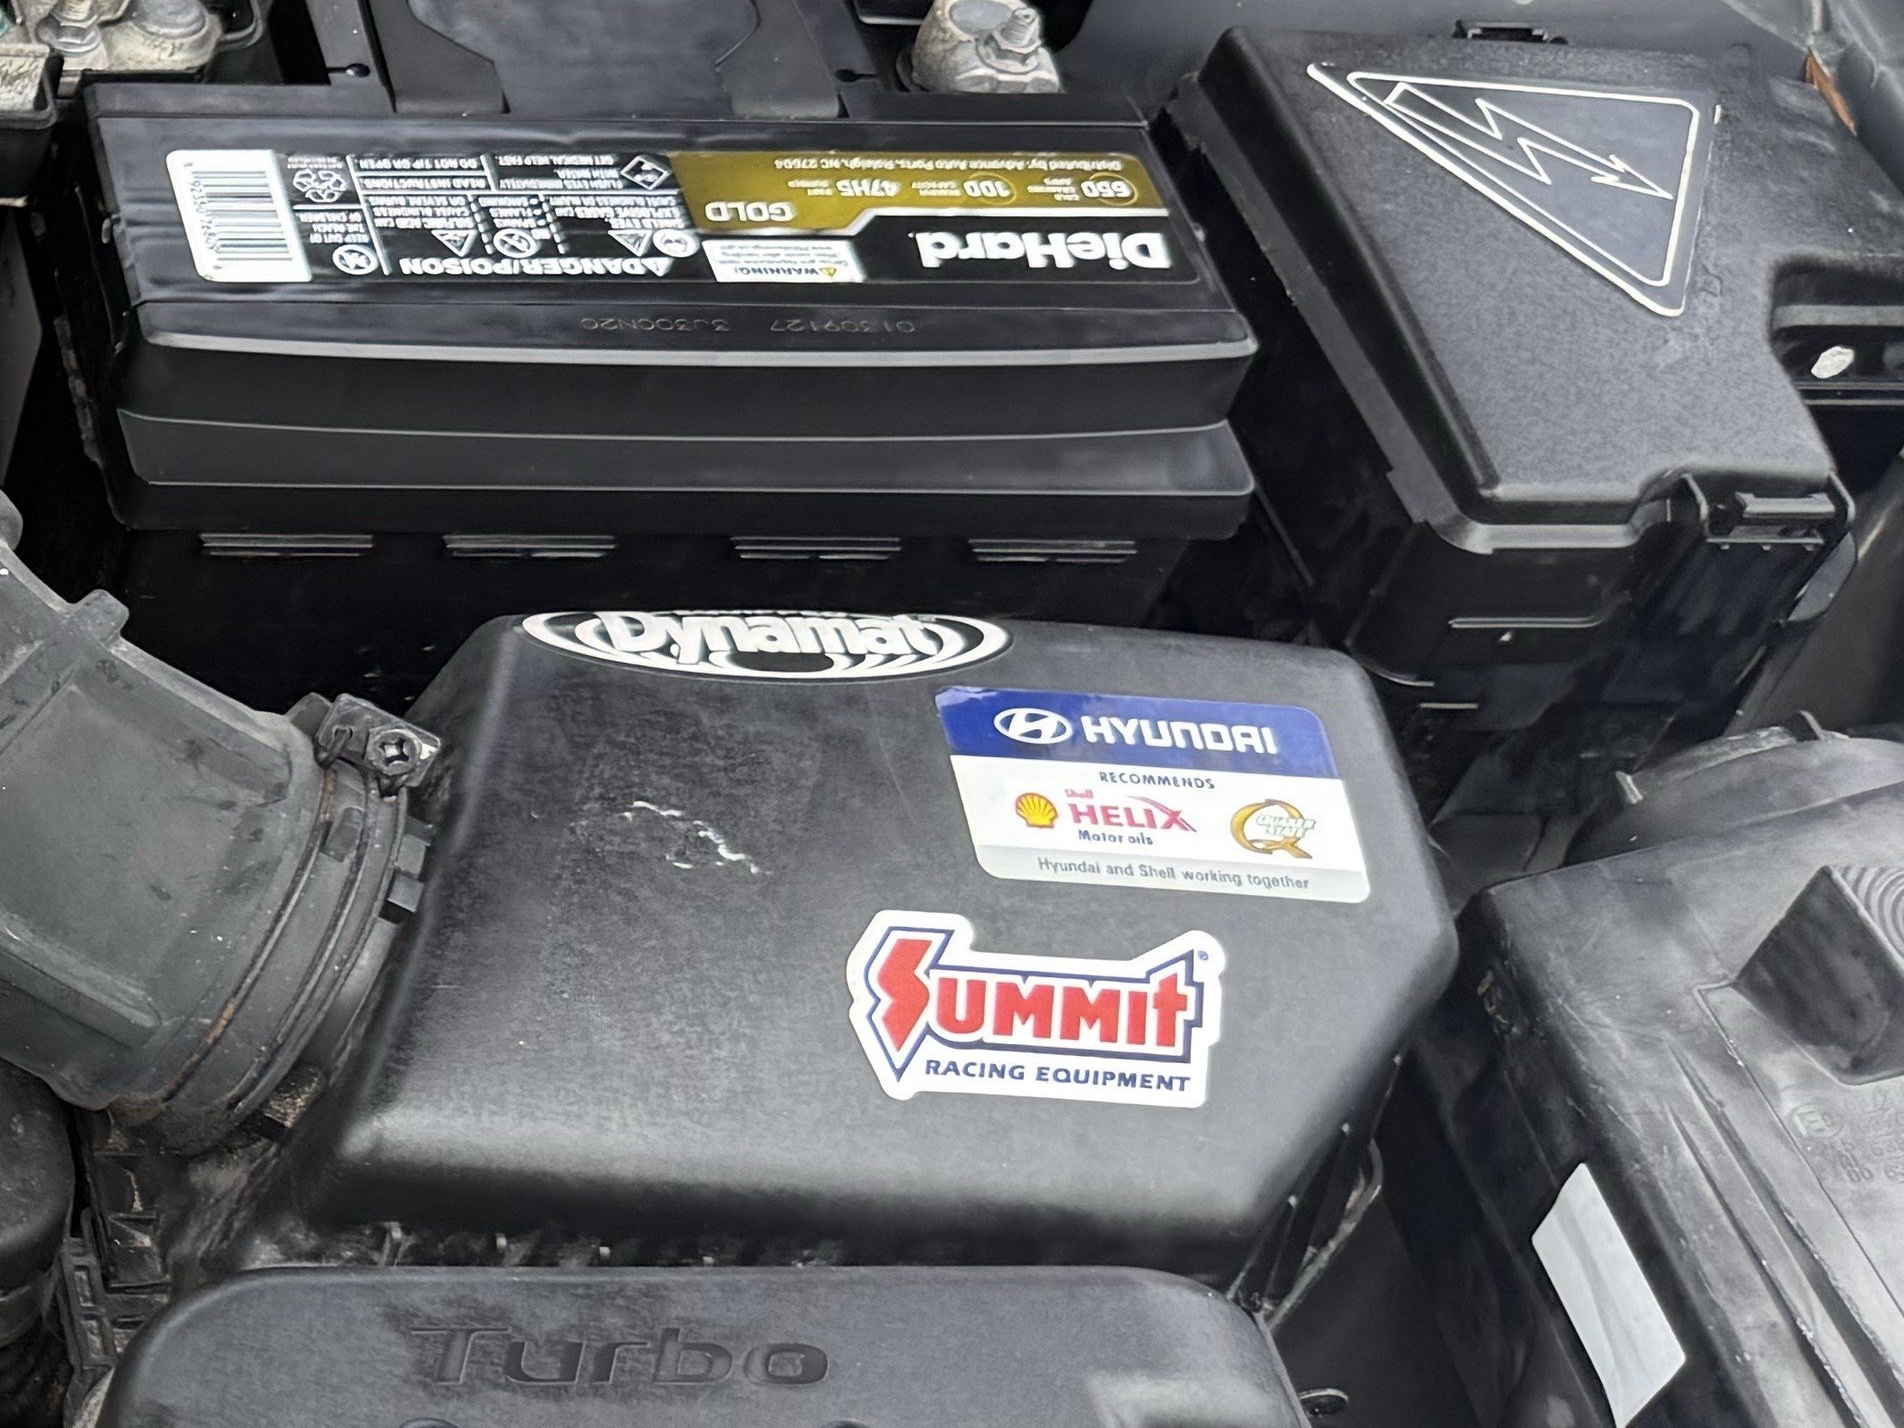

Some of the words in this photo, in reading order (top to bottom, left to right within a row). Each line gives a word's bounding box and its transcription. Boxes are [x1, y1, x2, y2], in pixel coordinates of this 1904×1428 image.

[820, 159, 840, 168] NC
[935, 160, 967, 170] Auto
[969, 160, 1025, 170] Advance
[836, 179, 900, 196] 47H5
[963, 180, 1010, 198] 100
[1081, 180, 1132, 198] 650
[704, 201, 793, 221] GOLD
[399, 258, 646, 274] DANGER/POISON
[602, 609, 940, 664] Dynamat
[1080, 715, 1277, 754] HYUNDAI
[1100, 772, 1215, 790] RECOMMENDS
[1068, 798, 1195, 832] HELIX
[1078, 830, 1123, 843] Motor
[1128, 832, 1153, 846] oils
[1038, 857, 1101, 878] Hyundai
[1106, 864, 1135, 878] and
[1139, 862, 1176, 880] Shell
[1182, 869, 1243, 888] working
[1247, 871, 1309, 891] together
[926, 1059, 1025, 1082] RACING
[1036, 1066, 1191, 1092] EQUIPMENT
[410, 1328, 829, 1386] Turbo
